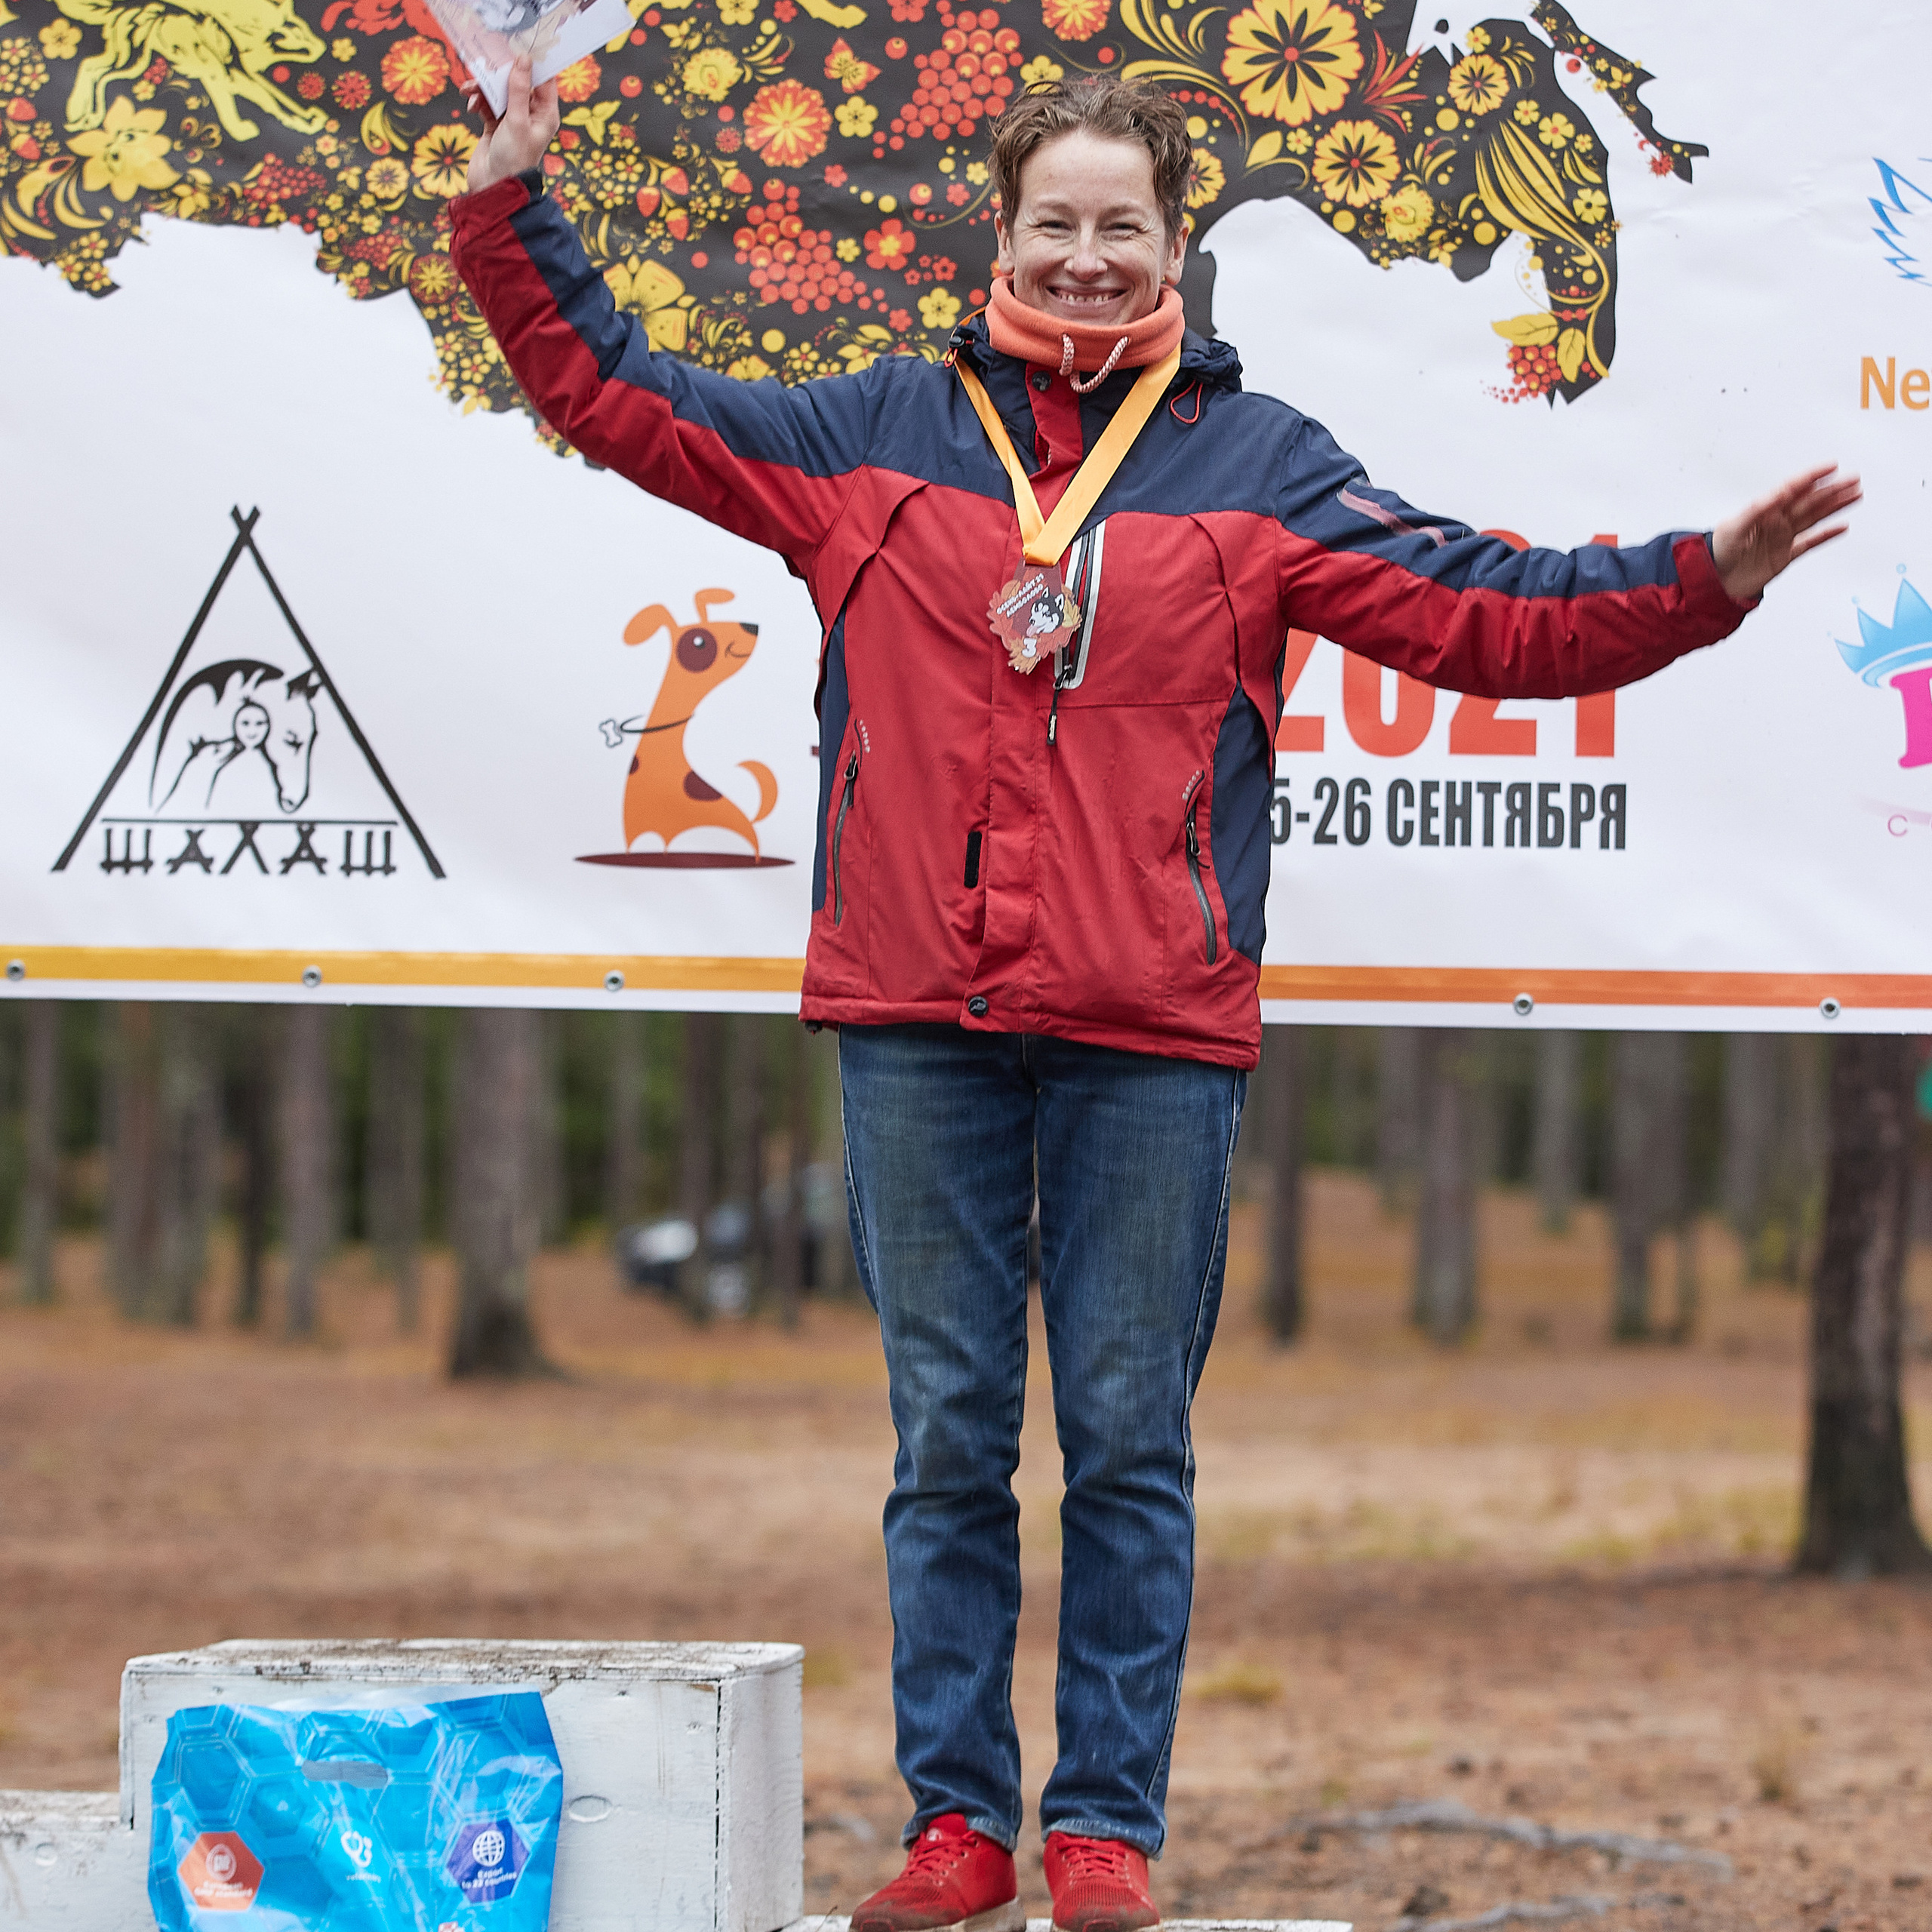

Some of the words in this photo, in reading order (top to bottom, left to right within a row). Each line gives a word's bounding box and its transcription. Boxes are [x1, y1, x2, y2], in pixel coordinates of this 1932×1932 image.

[1860, 355, 1932, 411] Ne
[1022, 637, 1037, 658] 3
[1387, 779, 1627, 851] СЕНТЯБРЯ
